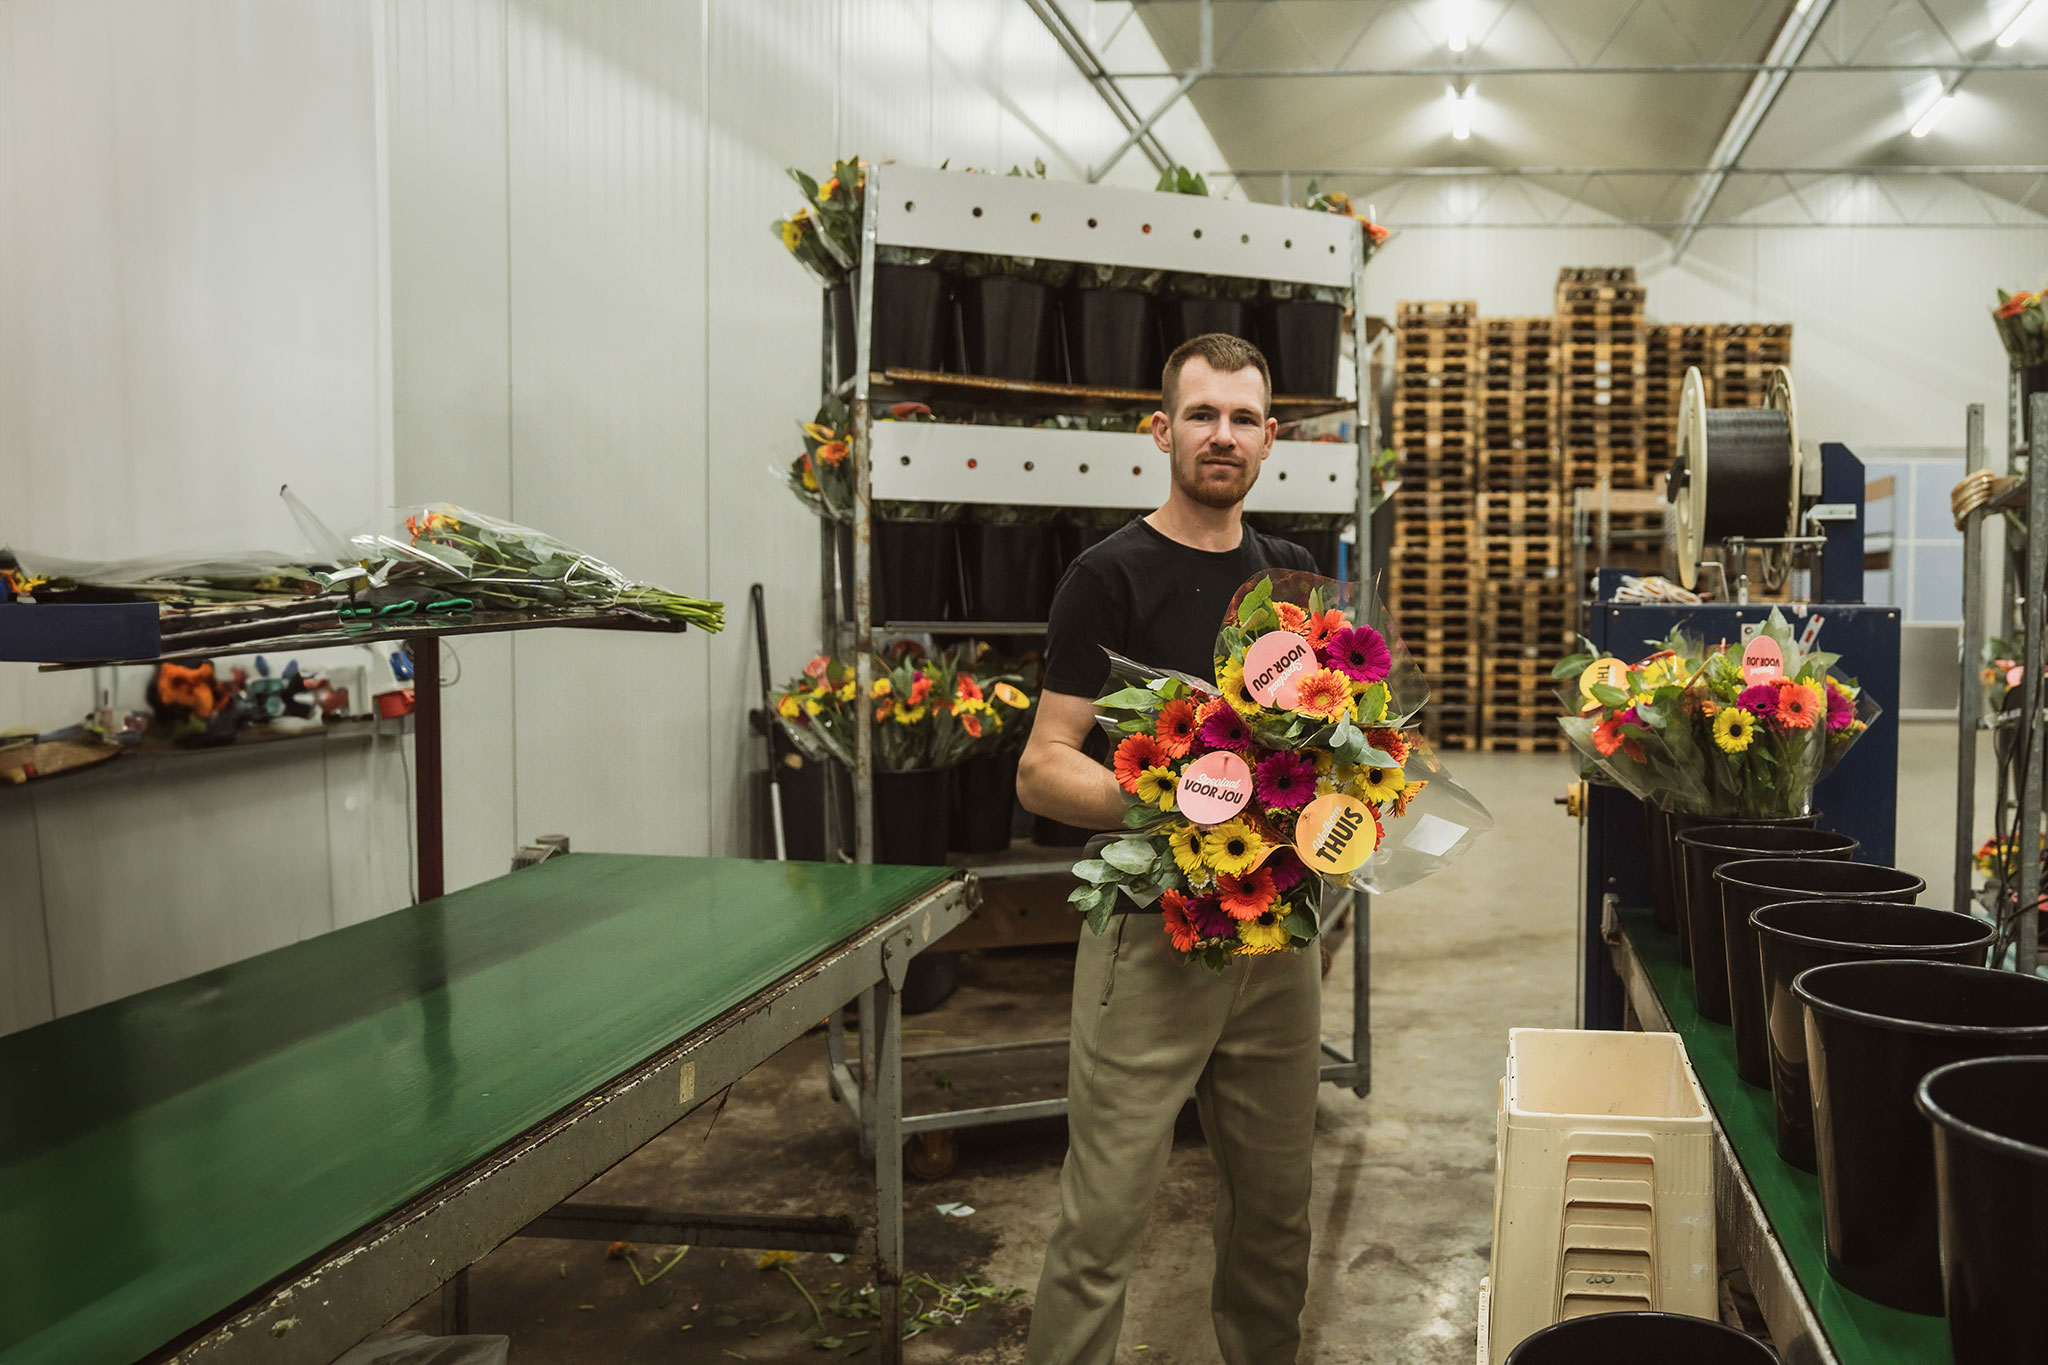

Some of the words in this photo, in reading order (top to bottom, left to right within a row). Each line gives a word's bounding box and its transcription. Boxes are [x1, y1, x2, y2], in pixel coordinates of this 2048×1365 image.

[1273, 644, 1307, 673] VOOR
[1746, 656, 1760, 667] JOU
[1761, 657, 1780, 668] VOOR
[1252, 667, 1274, 692] JOU
[1184, 779, 1219, 798] VOOR
[1217, 789, 1244, 804] JOU
[1312, 805, 1343, 850] Welkom
[1315, 806, 1364, 864] THUIS
